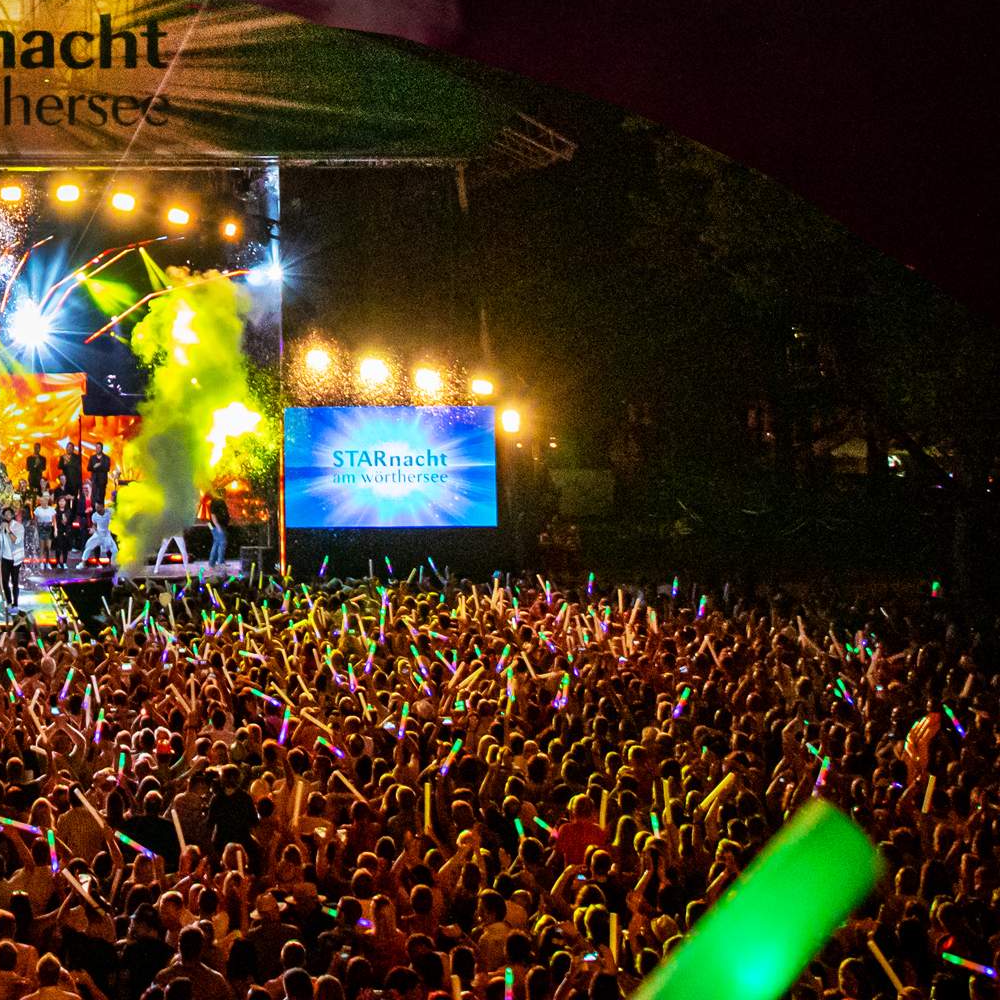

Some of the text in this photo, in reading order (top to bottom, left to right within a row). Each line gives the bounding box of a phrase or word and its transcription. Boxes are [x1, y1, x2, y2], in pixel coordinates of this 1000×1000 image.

[332, 449, 448, 468] STARnacht
[332, 469, 448, 483] am wörthersee
